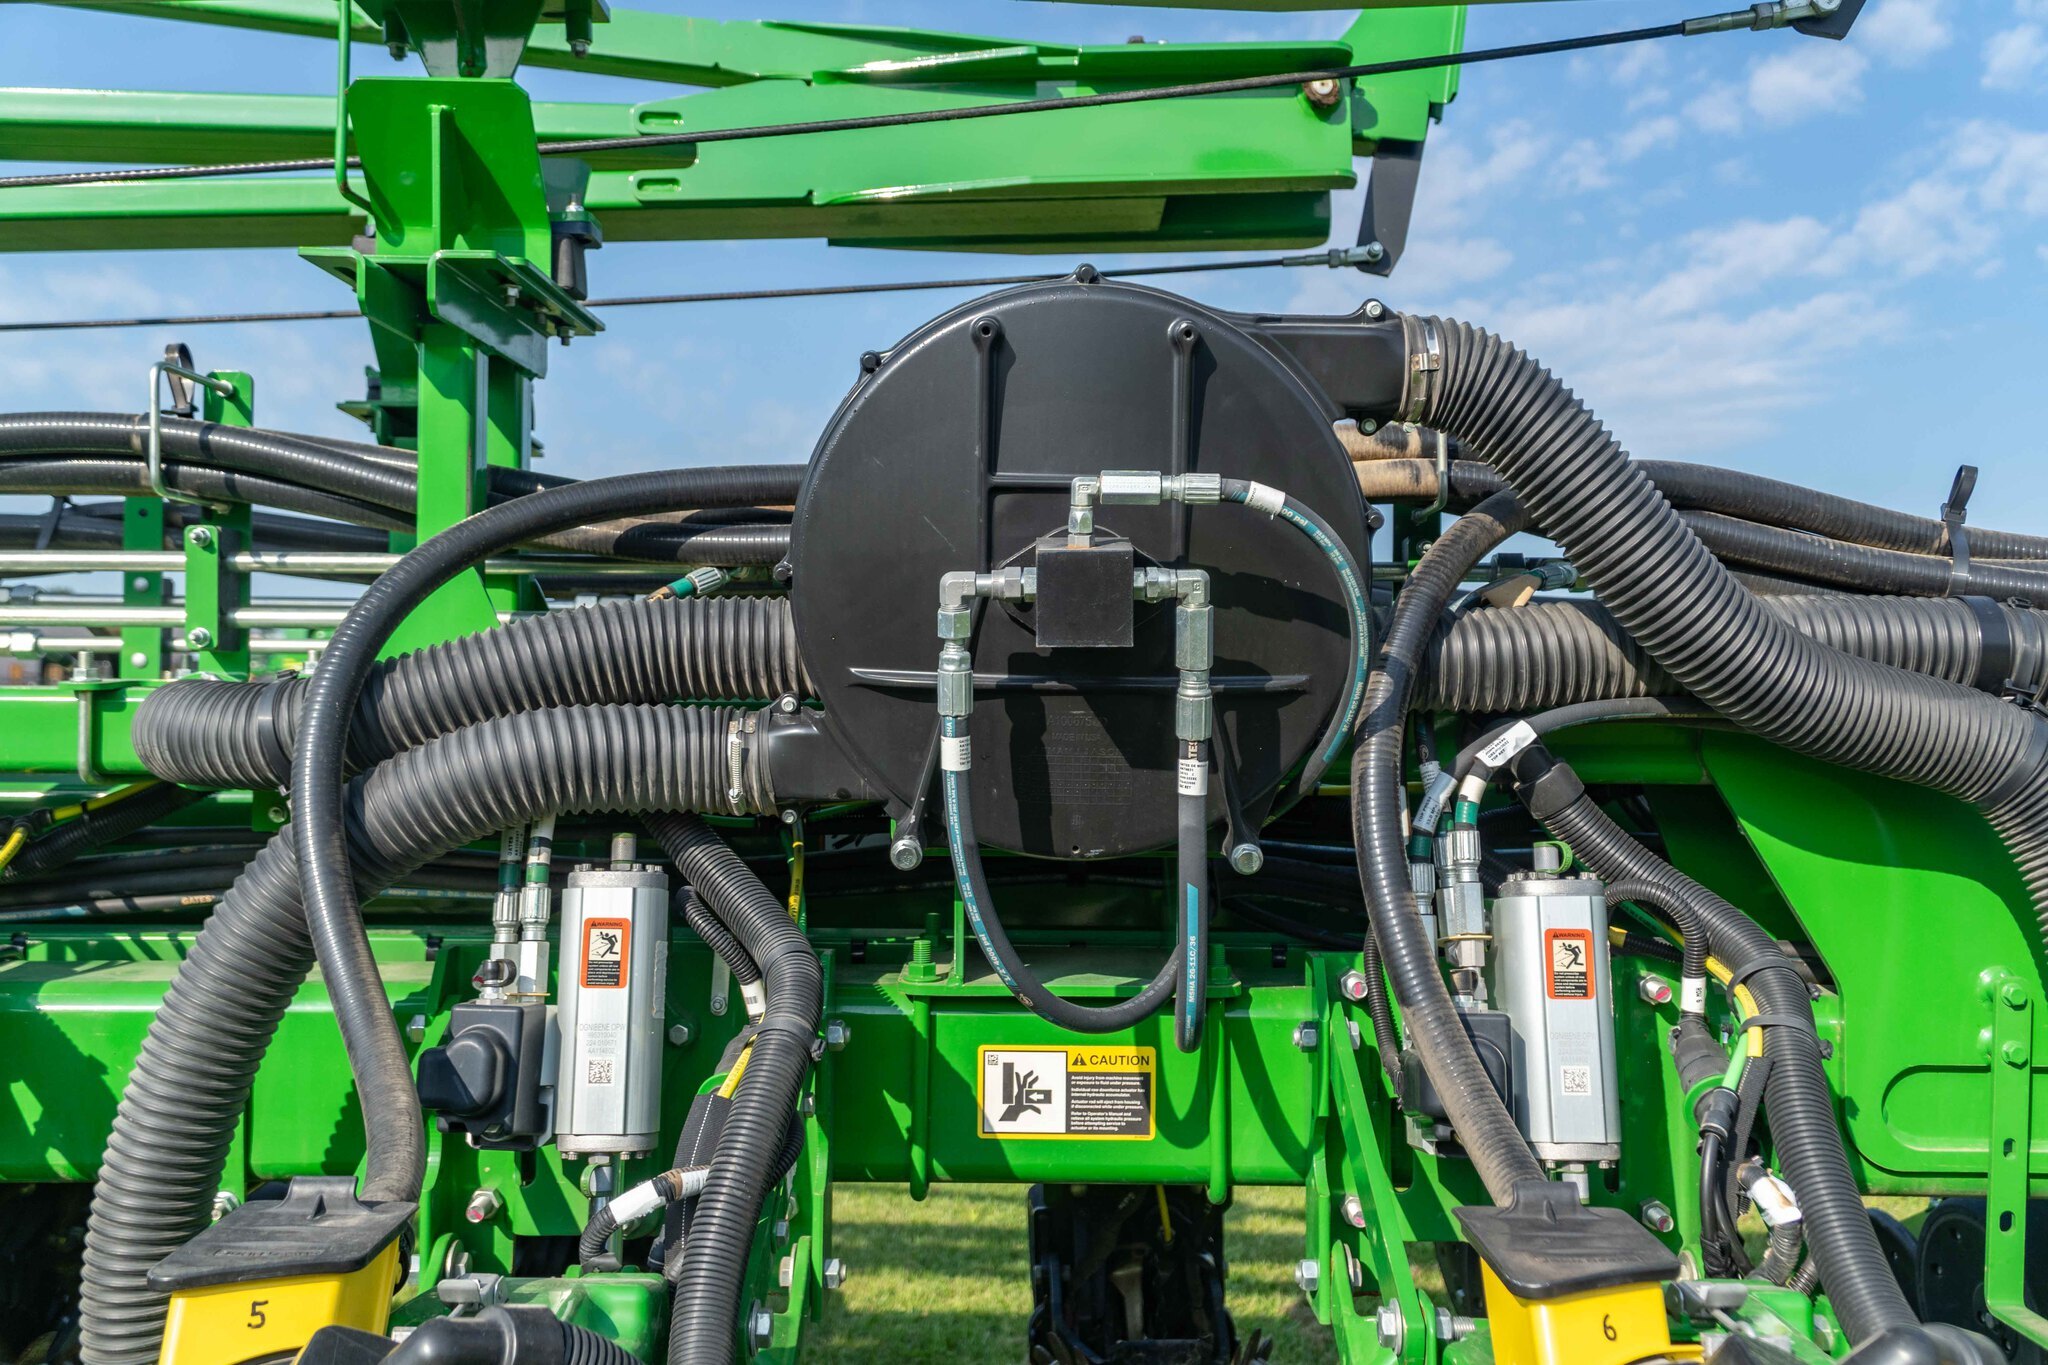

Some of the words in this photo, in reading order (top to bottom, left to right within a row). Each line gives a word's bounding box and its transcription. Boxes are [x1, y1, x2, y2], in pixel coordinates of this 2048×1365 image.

[181, 894, 215, 906] GATES
[986, 947, 1000, 966] 4000
[1090, 1055, 1150, 1066] CAUTION
[248, 1300, 267, 1328] 5
[1604, 1316, 1616, 1340] 6
